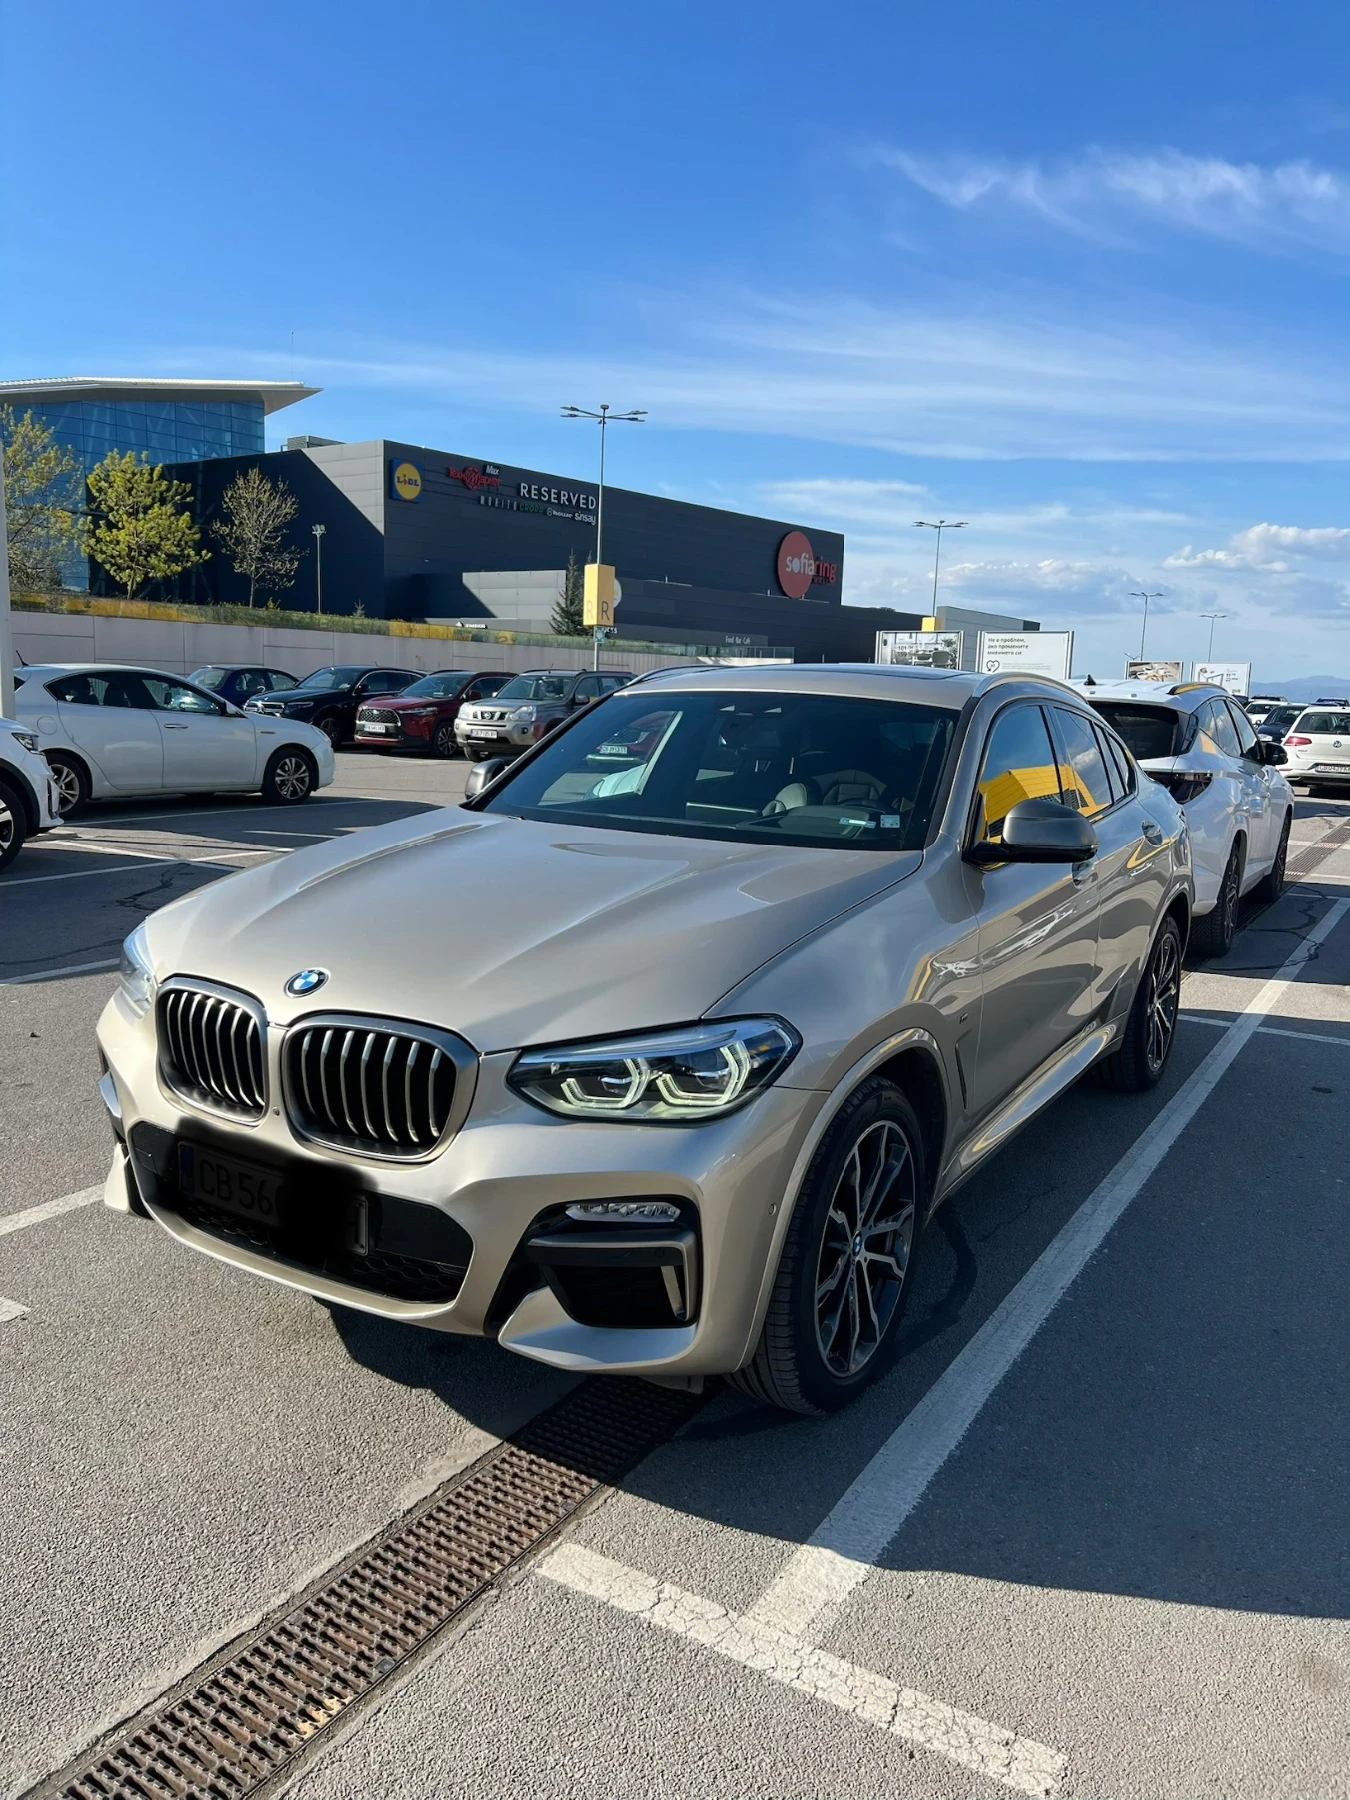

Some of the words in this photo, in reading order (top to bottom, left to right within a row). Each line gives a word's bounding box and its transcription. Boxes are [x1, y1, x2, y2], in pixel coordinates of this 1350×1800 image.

[485, 464, 499, 475] Max
[520, 482, 597, 510] RESERVED
[574, 511, 596, 526] sinsay
[601, 600, 610, 621] R
[199, 1158, 232, 1201] CB
